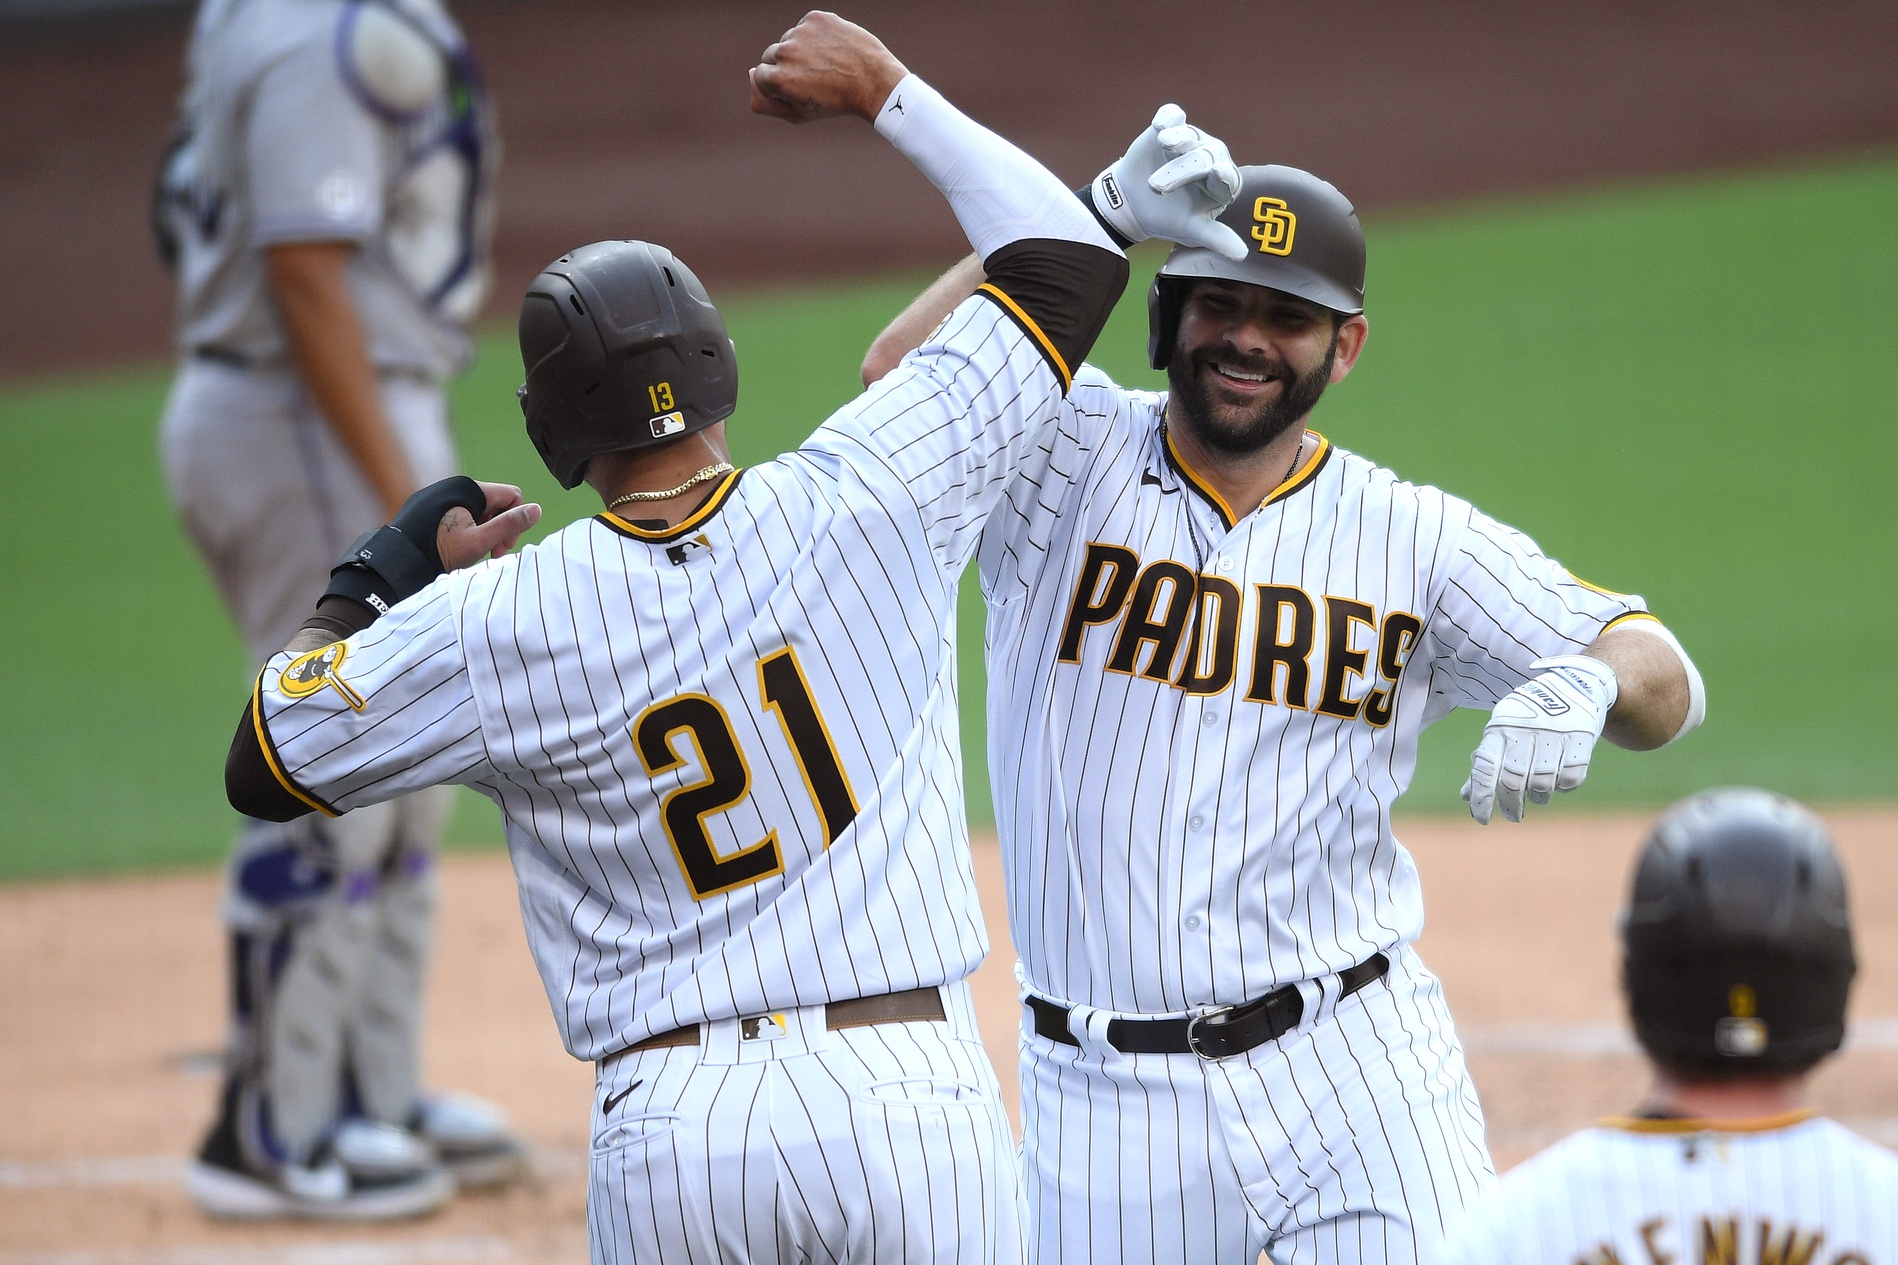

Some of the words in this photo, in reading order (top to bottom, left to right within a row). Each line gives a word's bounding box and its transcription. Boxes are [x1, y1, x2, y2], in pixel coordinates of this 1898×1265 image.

[1251, 196, 1297, 256] SD
[648, 381, 675, 413] 13
[1058, 541, 1421, 728] PADRES
[632, 644, 861, 902] 21
